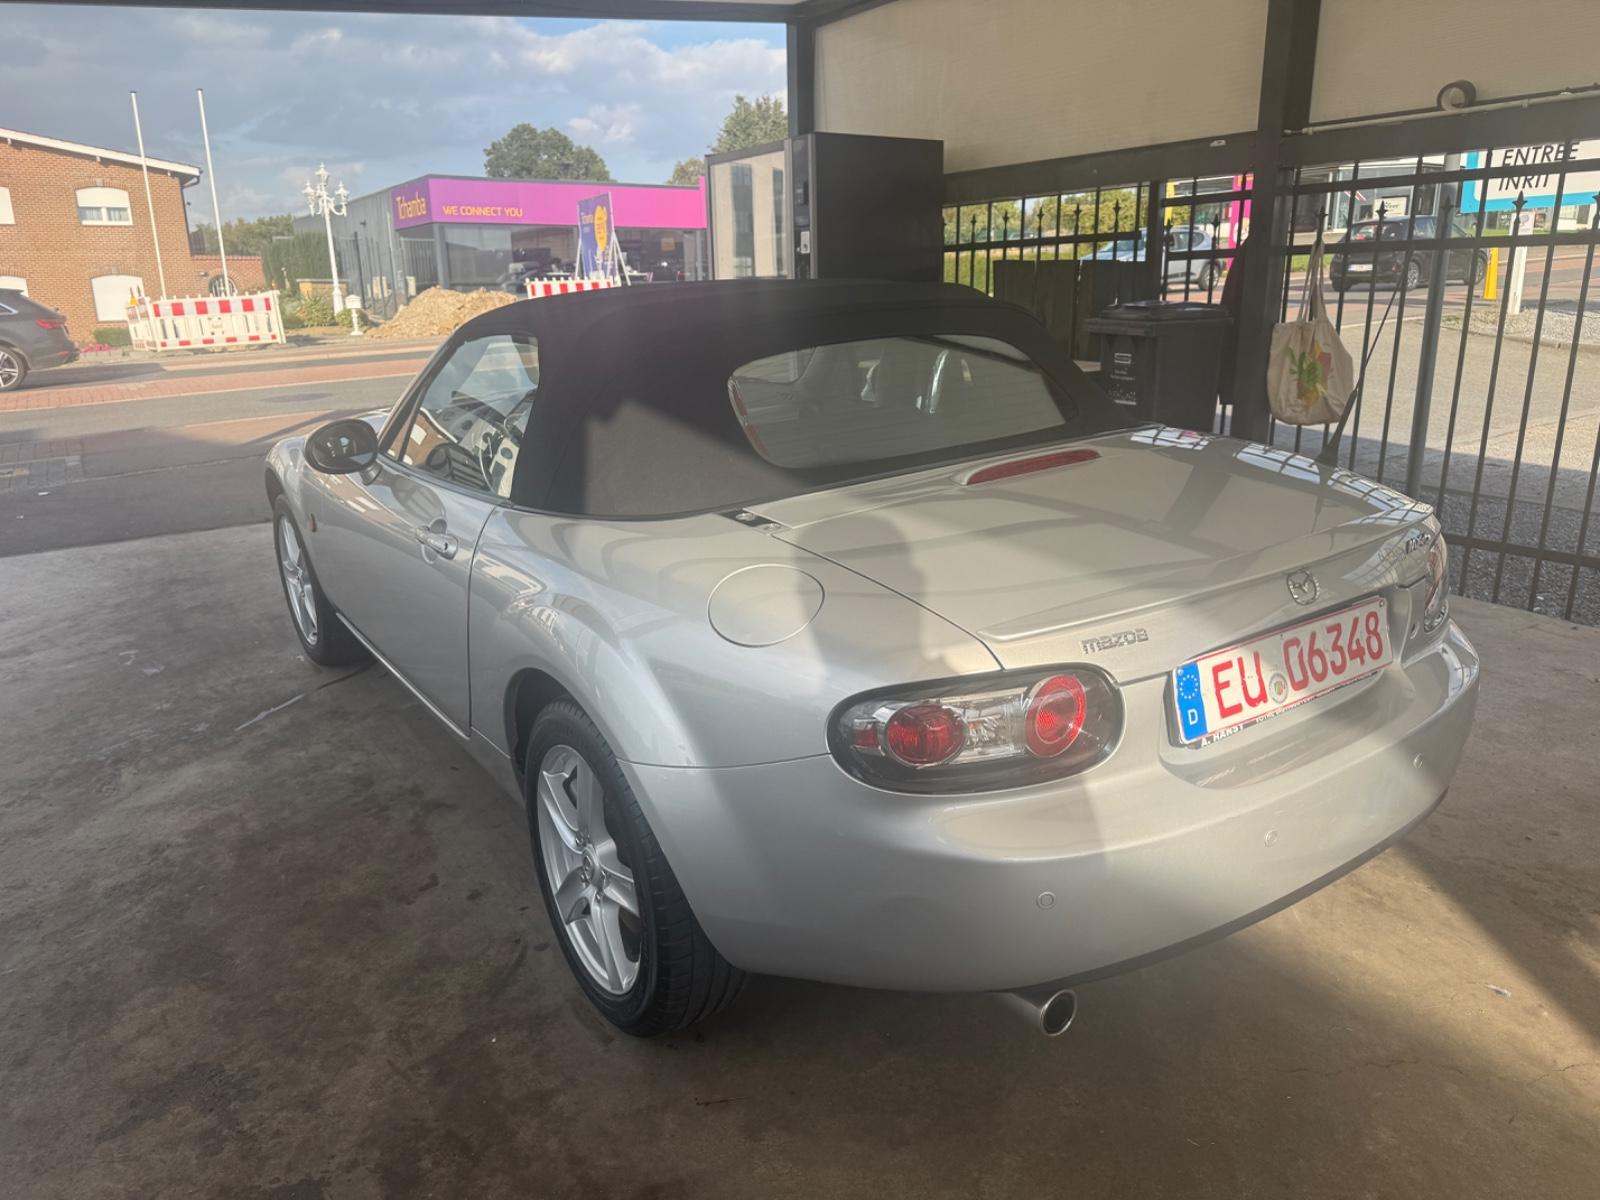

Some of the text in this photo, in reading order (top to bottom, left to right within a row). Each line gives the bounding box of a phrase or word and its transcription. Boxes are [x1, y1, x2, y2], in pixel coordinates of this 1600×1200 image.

[442, 205, 523, 217] WE CONNECT YOU
[1211, 651, 1269, 719] EU
[1282, 610, 1384, 694] 06348
[1187, 708, 1198, 726] D
